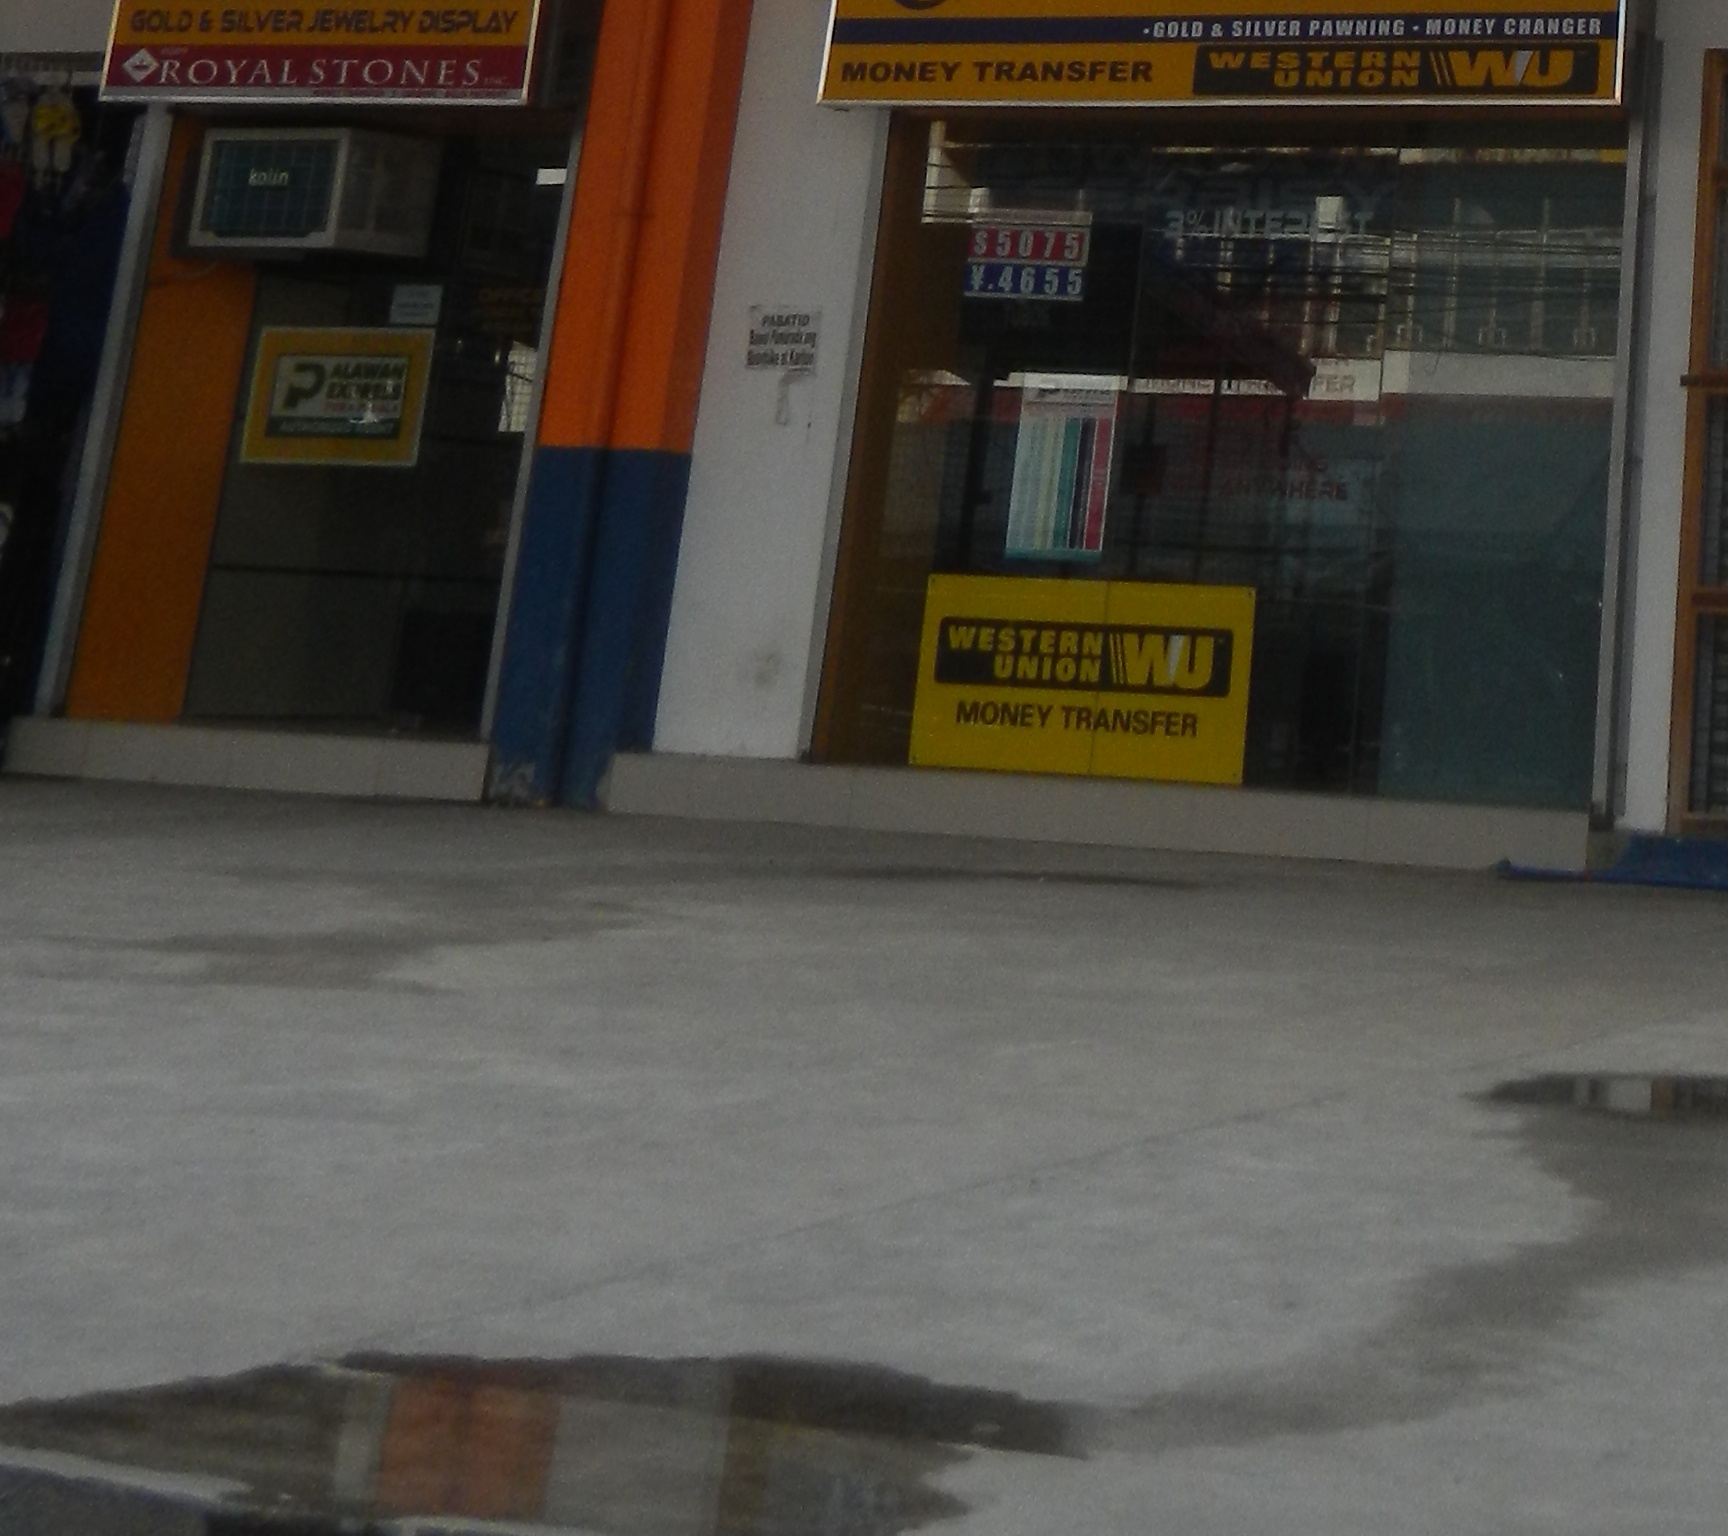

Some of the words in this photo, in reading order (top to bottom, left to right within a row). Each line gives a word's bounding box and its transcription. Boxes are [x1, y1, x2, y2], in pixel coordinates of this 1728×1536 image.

[130, 10, 191, 33] GOLD
[198, 10, 212, 32] &
[220, 10, 303, 33] SILVER
[306, 9, 413, 33] JEWELRY
[417, 9, 519, 33] DISPLAY
[1211, 22, 1223, 38] &
[1231, 20, 1301, 38] SILVER
[1308, 18, 1406, 37] PAWNING
[1425, 18, 1496, 36] MONEY
[1503, 17, 1602, 36] CHANGER
[159, 58, 297, 85] ROYAL
[309, 58, 481, 85] STONES
[841, 60, 962, 84] MONEY
[972, 60, 1154, 84] TRANSFER
[1207, 50, 1422, 70] WESTERN
[1273, 70, 1421, 88] UNION
[950, 625, 1102, 656] WESTERN
[994, 654, 1101, 682] UNION
[956, 701, 1053, 728] MONEY
[1061, 705, 1198, 737] TRANSFER
